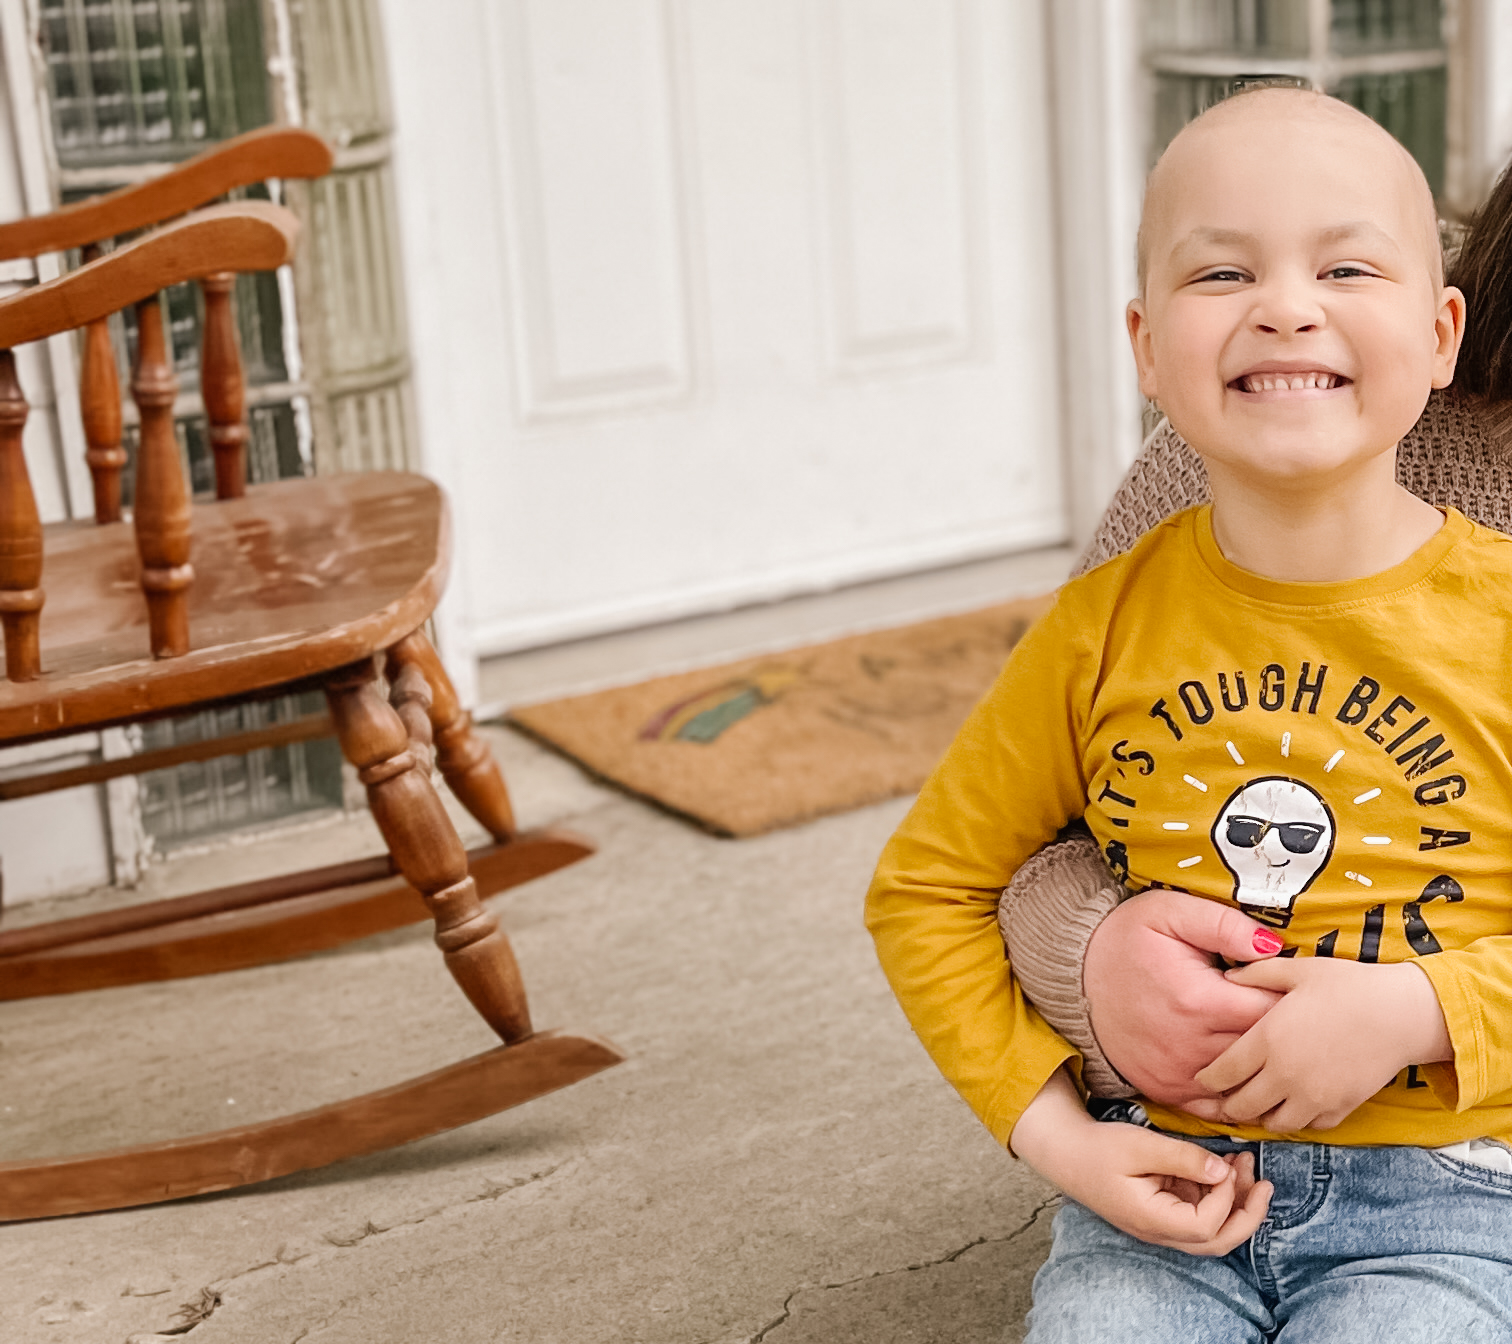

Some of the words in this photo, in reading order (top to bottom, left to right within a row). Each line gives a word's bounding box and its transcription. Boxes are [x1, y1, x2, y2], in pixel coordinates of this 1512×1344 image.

[1149, 662, 1328, 741] TOUGH
[1336, 676, 1466, 806] BEING
[1419, 826, 1471, 851] A
